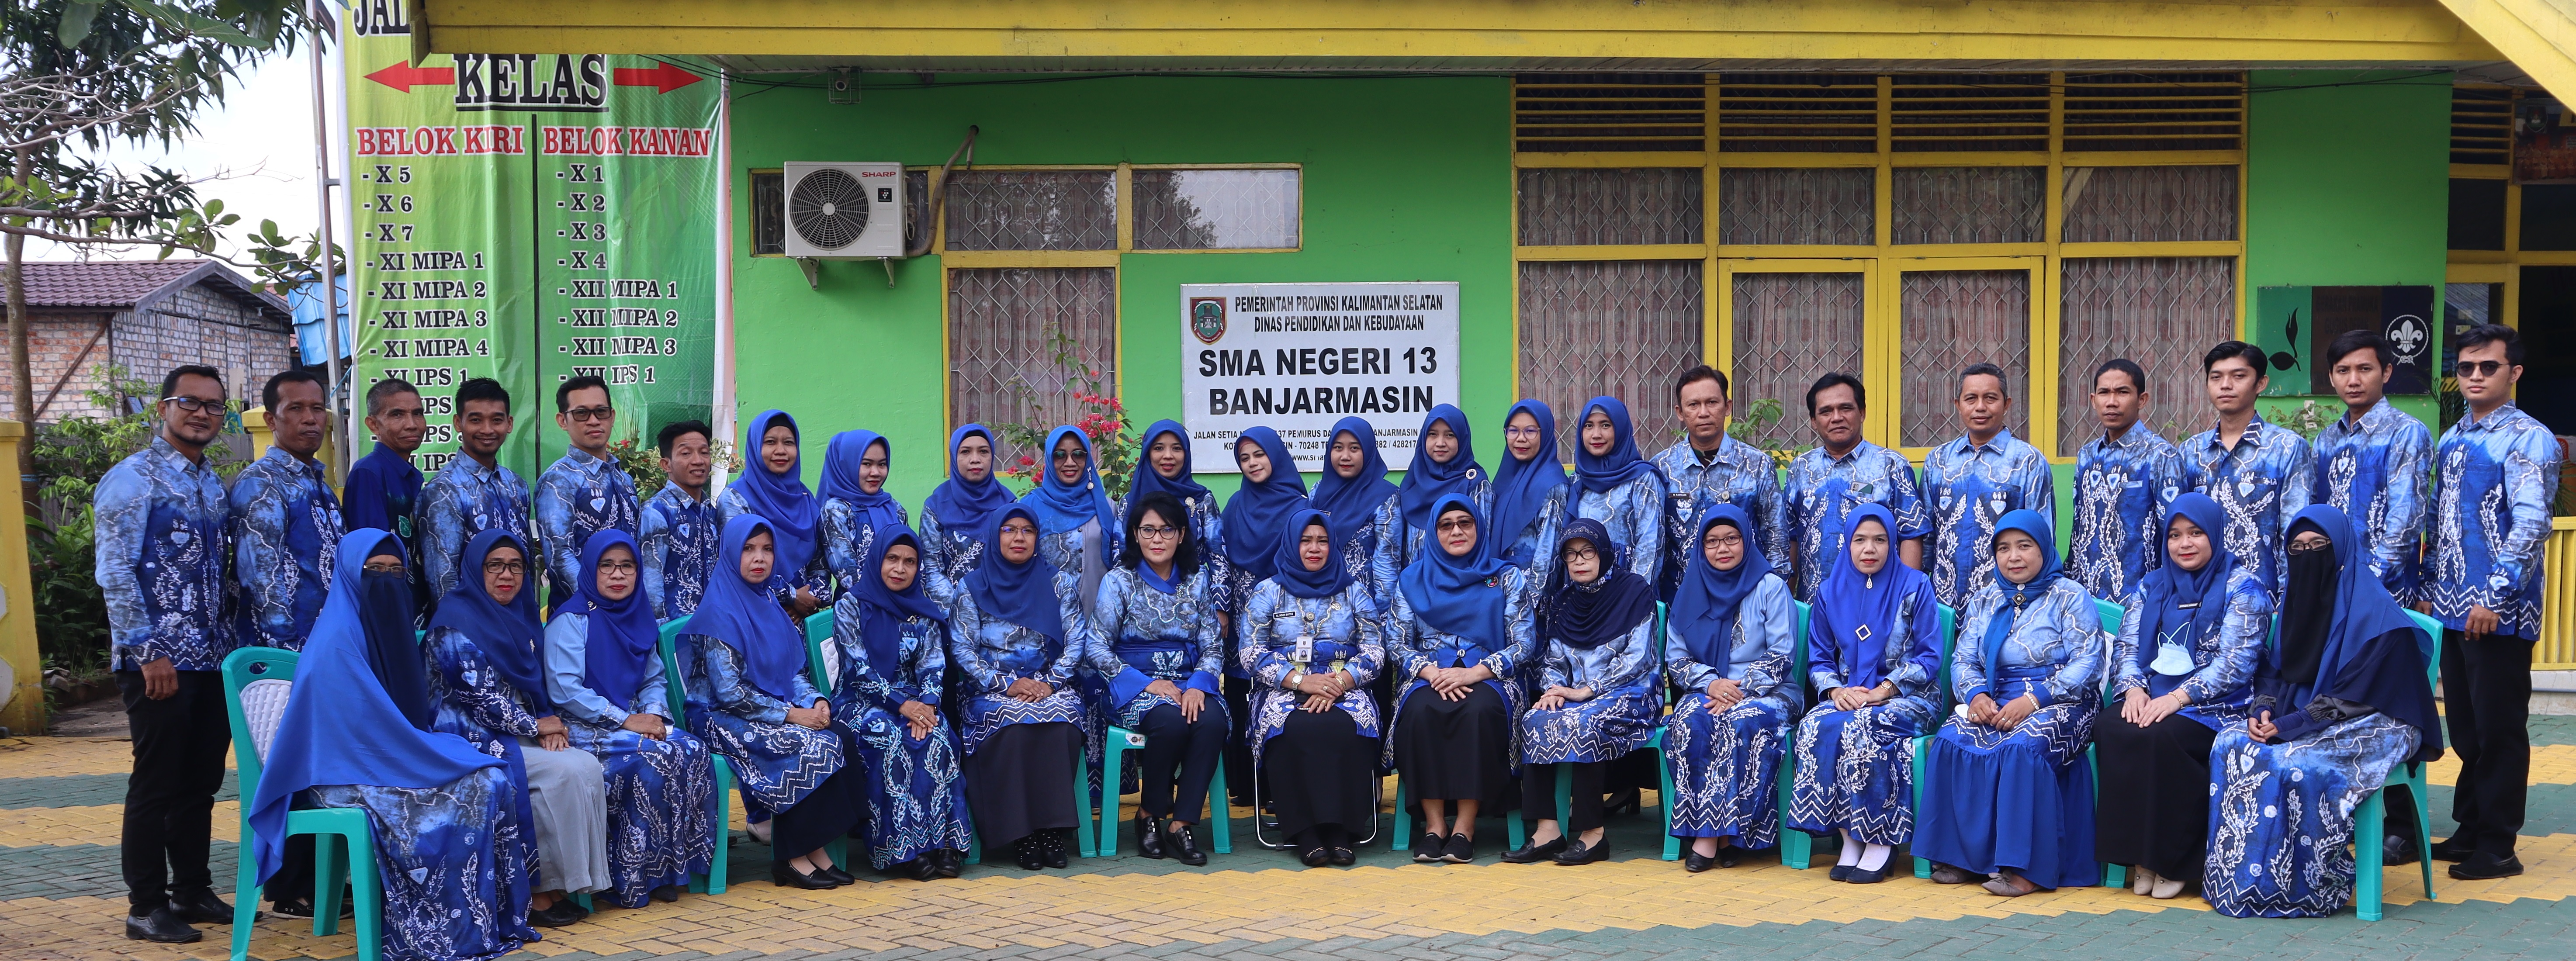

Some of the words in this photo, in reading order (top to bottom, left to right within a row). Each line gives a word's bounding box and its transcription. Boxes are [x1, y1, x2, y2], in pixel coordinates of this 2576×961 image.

[453, 55, 605, 107] KELAS
[357, 127, 457, 155] BELOK
[464, 126, 523, 154] KIRI
[544, 127, 623, 155] BELOK
[629, 128, 710, 156] KANAN
[376, 165, 392, 183] X
[399, 166, 411, 183] 5
[570, 164, 586, 182] X
[594, 166, 603, 182] 1
[377, 194, 394, 212] X
[401, 196, 412, 212] 6
[571, 193, 586, 211] X
[593, 195, 605, 211] 2
[378, 224, 395, 242] X
[402, 225, 413, 241] 7
[571, 222, 587, 240] X
[593, 224, 606, 240] 3
[380, 253, 405, 271] XI
[411, 252, 467, 270] MIPA
[474, 253, 484, 269] 1
[571, 251, 587, 269] X
[593, 253, 606, 269] 4
[381, 282, 407, 300] XI
[412, 281, 468, 299] MIPA
[474, 281, 486, 298] 2
[572, 280, 605, 298] XII
[611, 280, 661, 298] MIPA
[668, 283, 677, 298] 1
[1235, 296, 1293, 312] PEMERINTAH
[1296, 295, 1339, 311] PROVINSI
[1342, 295, 1400, 311] KALIMANTAN
[1403, 294, 1443, 311] SELATAN
[382, 311, 408, 329] XI
[413, 310, 469, 328] MIPA
[475, 311, 487, 327] 3
[572, 309, 606, 327] XII
[611, 308, 660, 326] MIPA
[665, 311, 677, 327] 2
[1254, 316, 1282, 332] DINAS
[1285, 315, 1340, 332] PENDIDIKAN
[1343, 315, 1361, 331] DAN
[1364, 315, 1424, 331] KEBUDAYAAN
[383, 340, 408, 358] XI
[414, 339, 470, 357] MIPA
[476, 340, 488, 355] 4
[573, 338, 606, 356] XII
[611, 337, 658, 355] MIPA
[664, 339, 675, 355] 3
[1199, 349, 1266, 377] SMA
[1277, 348, 1390, 375] NEGERI
[1403, 346, 1437, 374] 13
[415, 367, 452, 386] IPS
[612, 365, 637, 384] IPS
[645, 367, 654, 382] 1
[1209, 386, 1433, 415] BANJARMASIN
[1194, 431, 1215, 439] JALAN
[1218, 430, 1237, 439] SETIA
